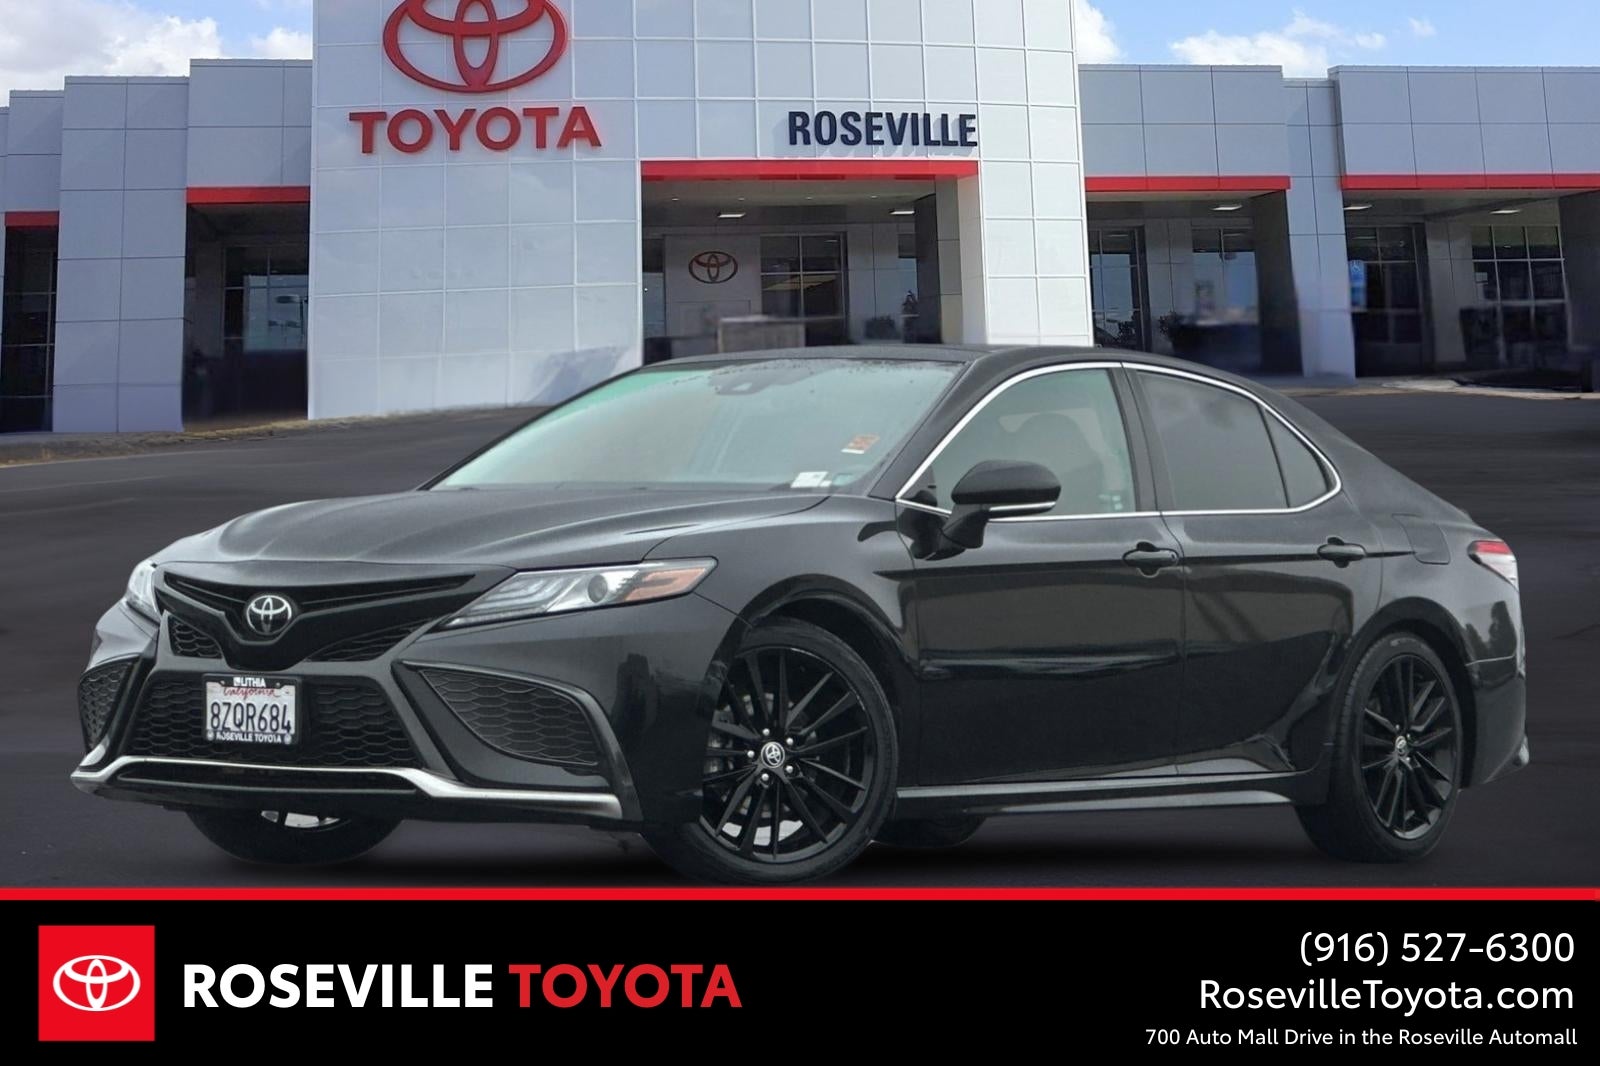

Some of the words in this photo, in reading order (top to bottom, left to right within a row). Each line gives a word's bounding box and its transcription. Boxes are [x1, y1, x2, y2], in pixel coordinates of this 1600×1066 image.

[349, 106, 602, 154] TOYOTA
[788, 110, 979, 148] ROSEVILLE
[223, 688, 275, 700] California
[210, 702, 292, 731] 8ZQR684
[216, 732, 253, 742] ROSEVILLE
[255, 734, 282, 743] TOYOTA
